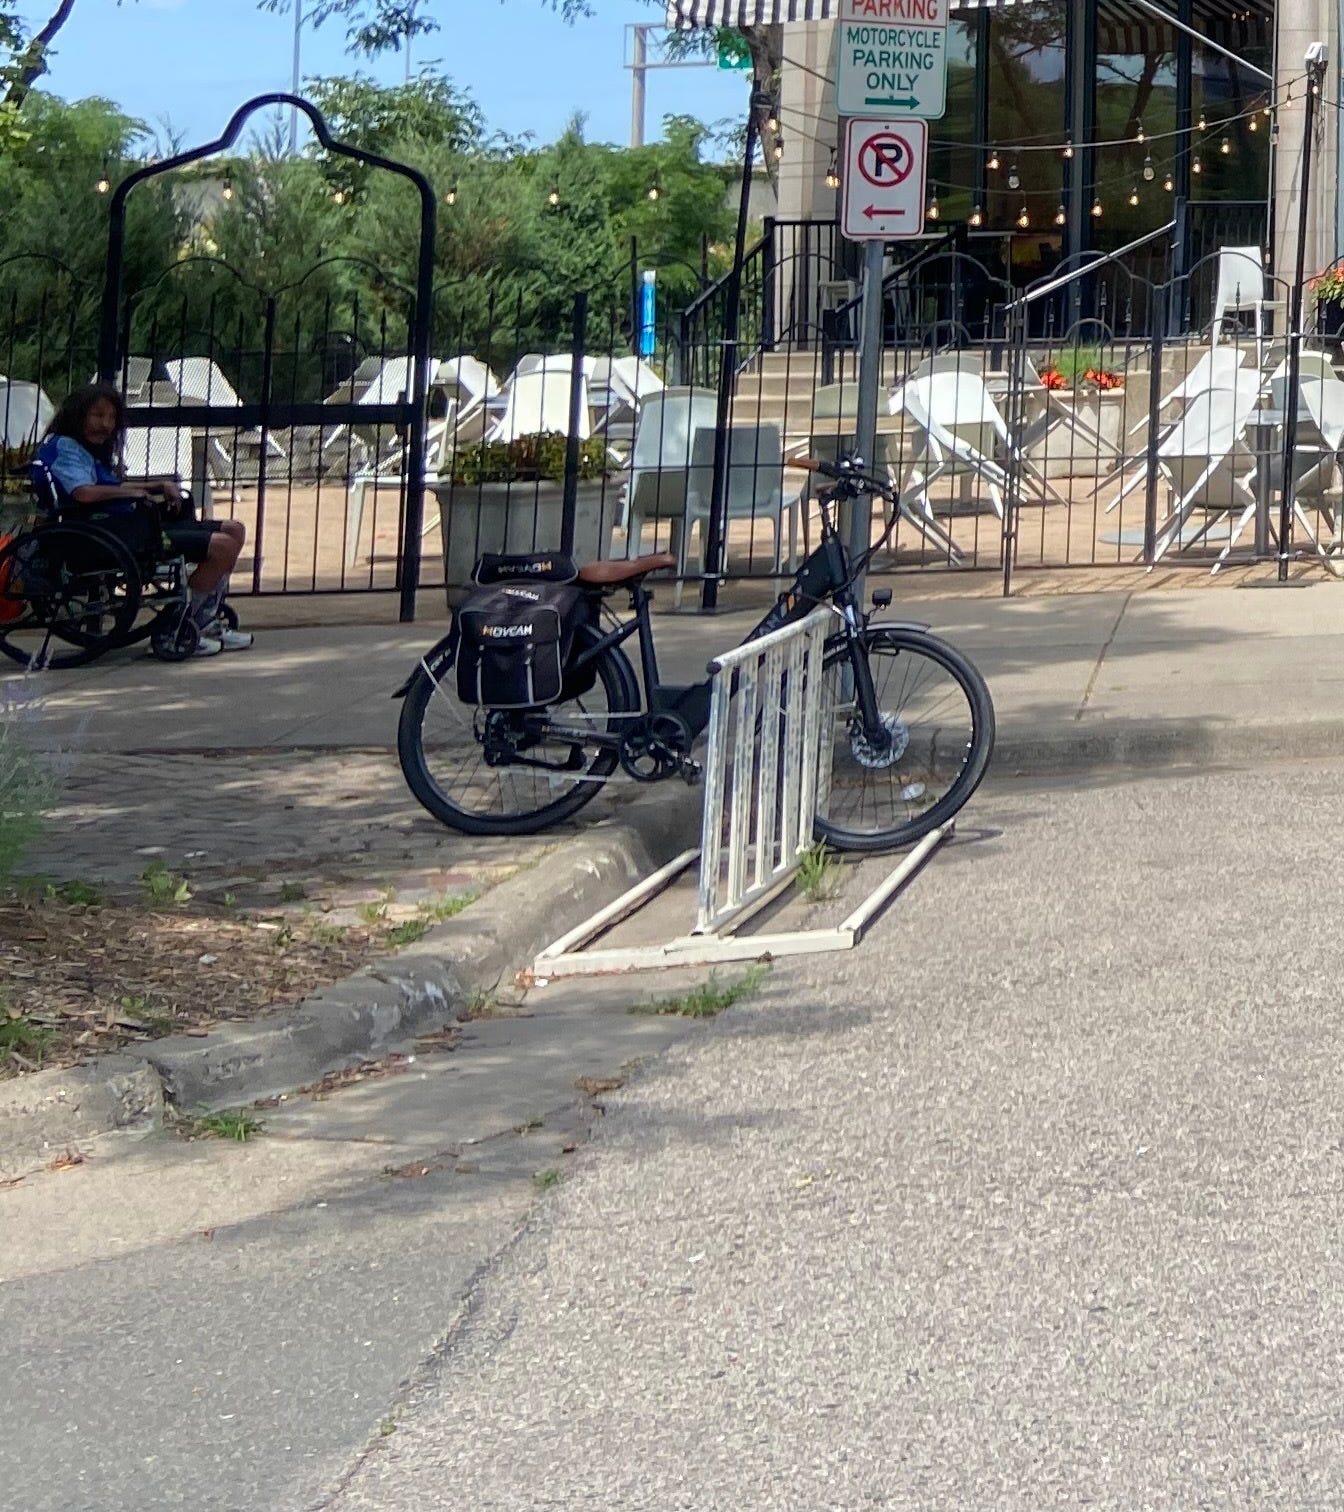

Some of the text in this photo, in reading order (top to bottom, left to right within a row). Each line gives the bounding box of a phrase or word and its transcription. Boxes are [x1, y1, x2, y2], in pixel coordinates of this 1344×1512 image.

[847, 26, 941, 49] MOTORCYCLE
[853, 49, 934, 70] PARKING
[866, 72, 920, 92] ONLY
